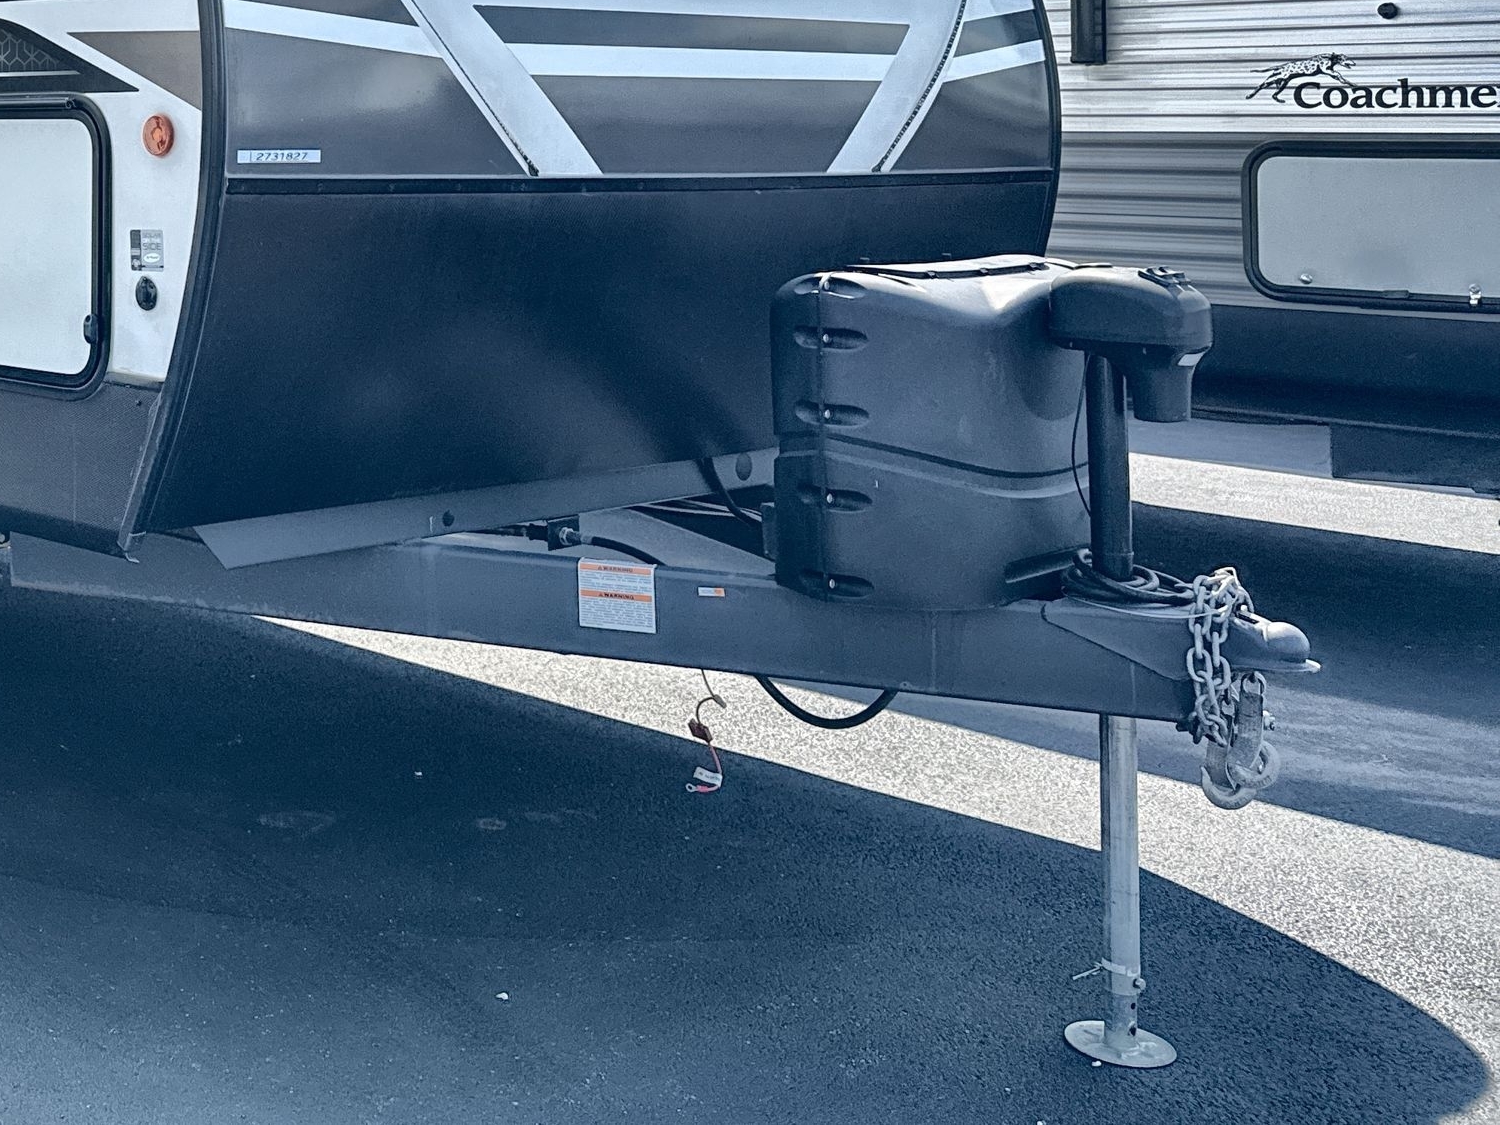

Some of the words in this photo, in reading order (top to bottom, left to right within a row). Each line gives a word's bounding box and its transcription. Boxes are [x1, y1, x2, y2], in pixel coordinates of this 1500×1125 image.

[1293, 78, 1500, 108] Coachme
[256, 152, 308, 161] 2731827
[604, 592, 635, 600] WARNING
